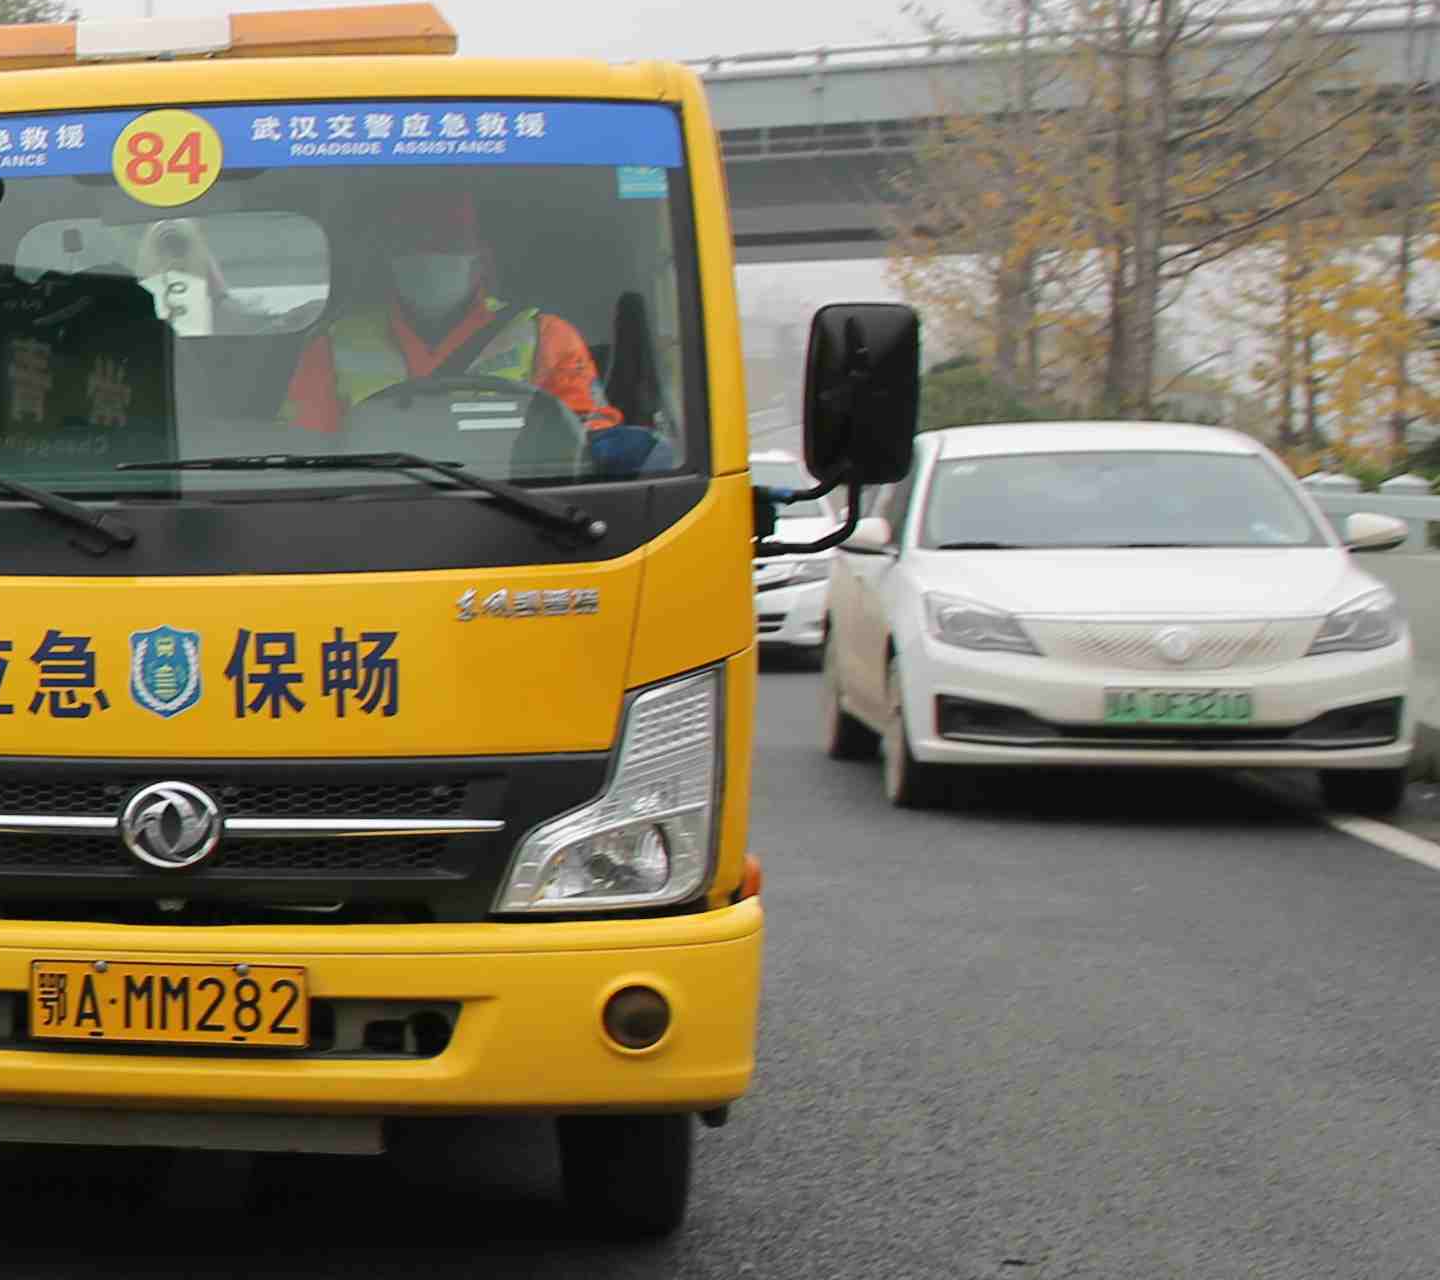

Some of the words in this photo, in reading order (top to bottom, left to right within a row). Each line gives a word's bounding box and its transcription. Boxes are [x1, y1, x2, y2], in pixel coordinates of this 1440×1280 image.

[251, 112, 546, 141] 武汉交警应急救援
[290, 142, 382, 157] ROADSIDE
[392, 139, 506, 154] ASSISTANCE
[125, 131, 208, 186] 84
[224, 627, 399, 718] 保畅
[38, 972, 300, 1034] 鄂A·MM282
